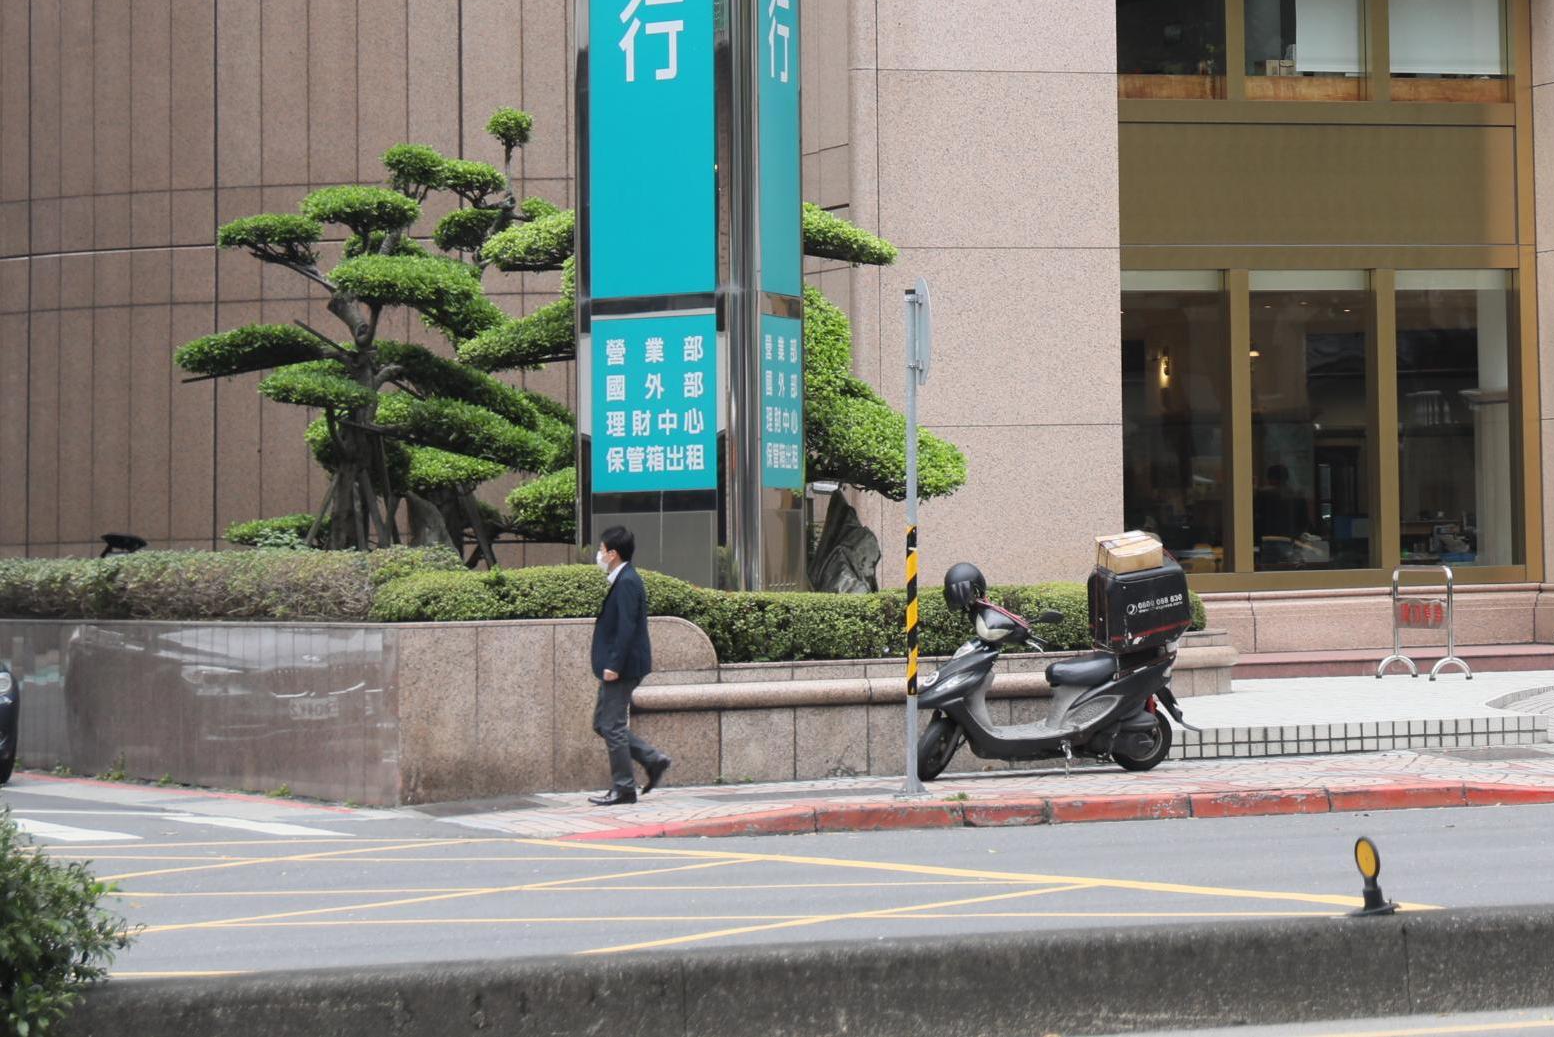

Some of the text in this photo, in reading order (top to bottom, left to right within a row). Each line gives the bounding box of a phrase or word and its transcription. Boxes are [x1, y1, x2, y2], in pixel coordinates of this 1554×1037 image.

[606, 335, 704, 366] 營業部
[606, 372, 704, 402] 國外部
[606, 408, 704, 437] 理財中心
[606, 444, 705, 474] 保管箱出租
